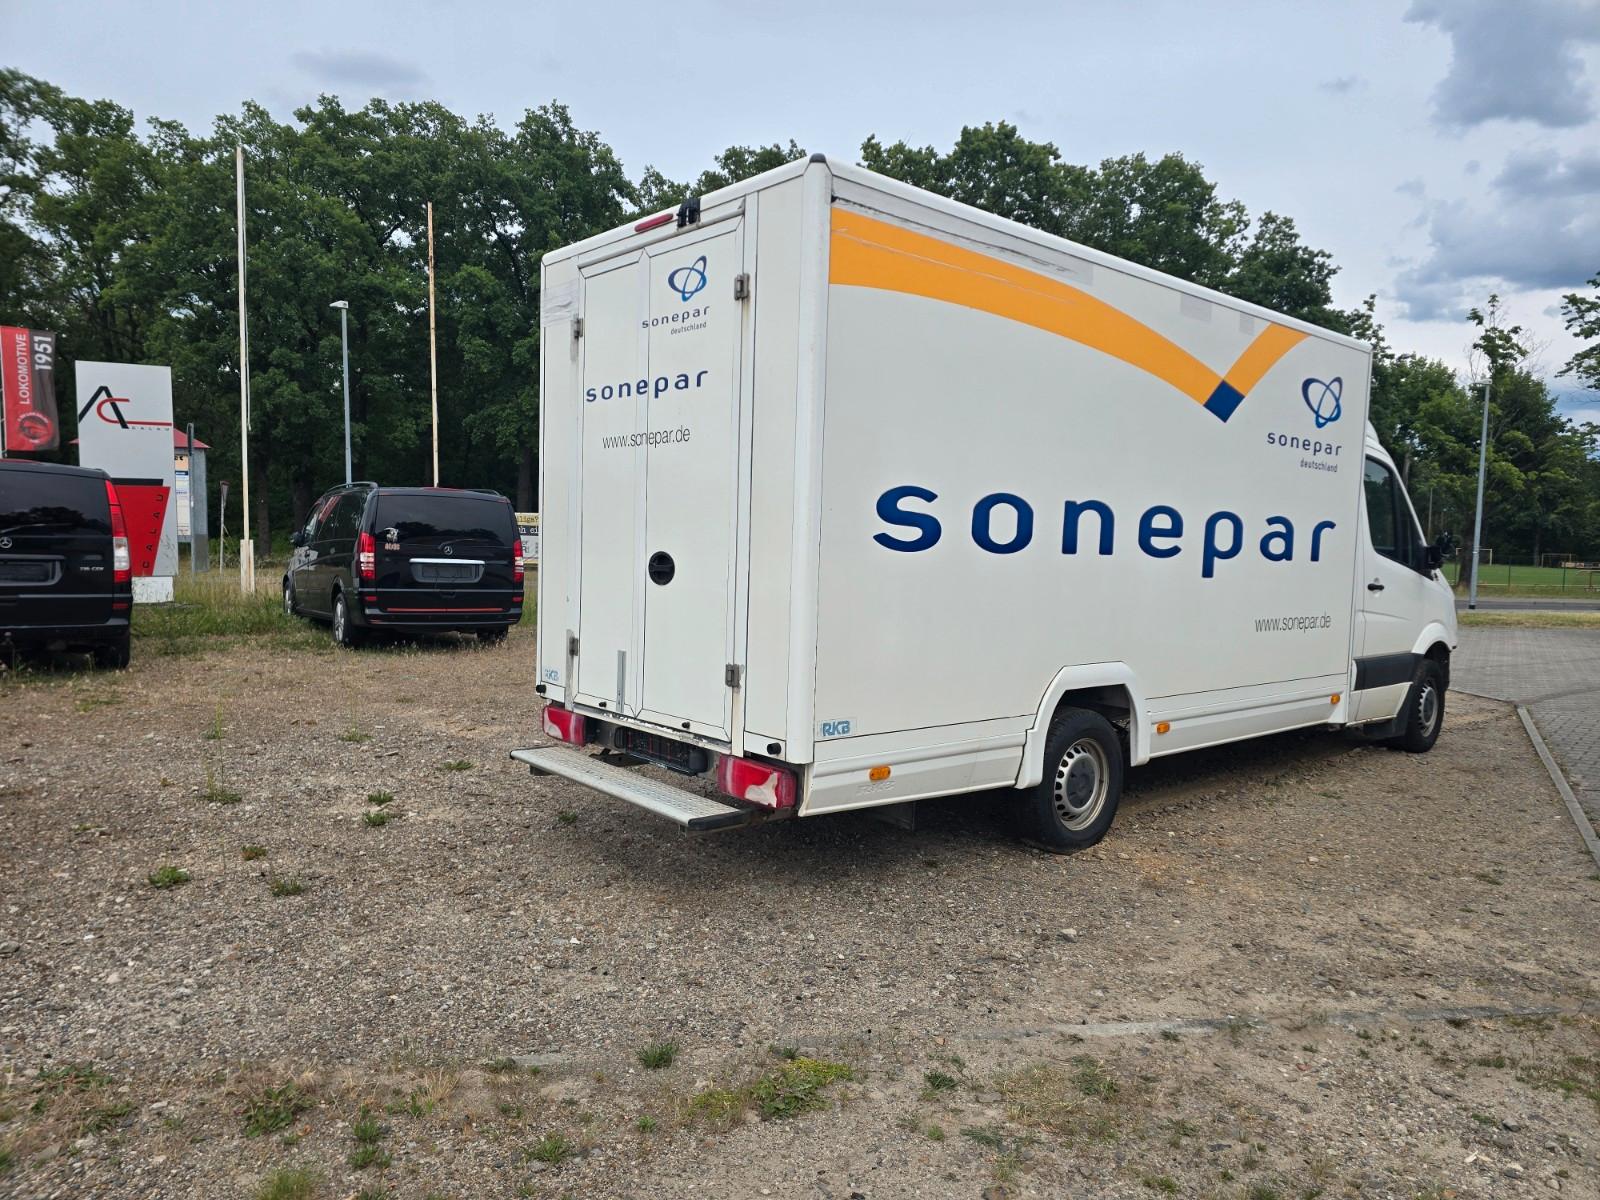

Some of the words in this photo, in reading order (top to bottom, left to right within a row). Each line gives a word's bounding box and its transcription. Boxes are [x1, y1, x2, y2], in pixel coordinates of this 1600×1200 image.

[641, 304, 711, 329] sonepar
[670, 321, 707, 335] deutschland
[33, 335, 52, 370] 1951
[15, 333, 31, 405] LOKOMOTIVE
[585, 370, 709, 403] sonepar
[602, 425, 691, 449] www.sonepar.de
[1266, 431, 1343, 456] sonepar
[1299, 458, 1338, 473] deutschland
[142, 494, 164, 568] CALAU
[873, 485, 1337, 578] sonepar
[1254, 611, 1332, 633] www.sonepar.de
[822, 720, 850, 736] RKB
